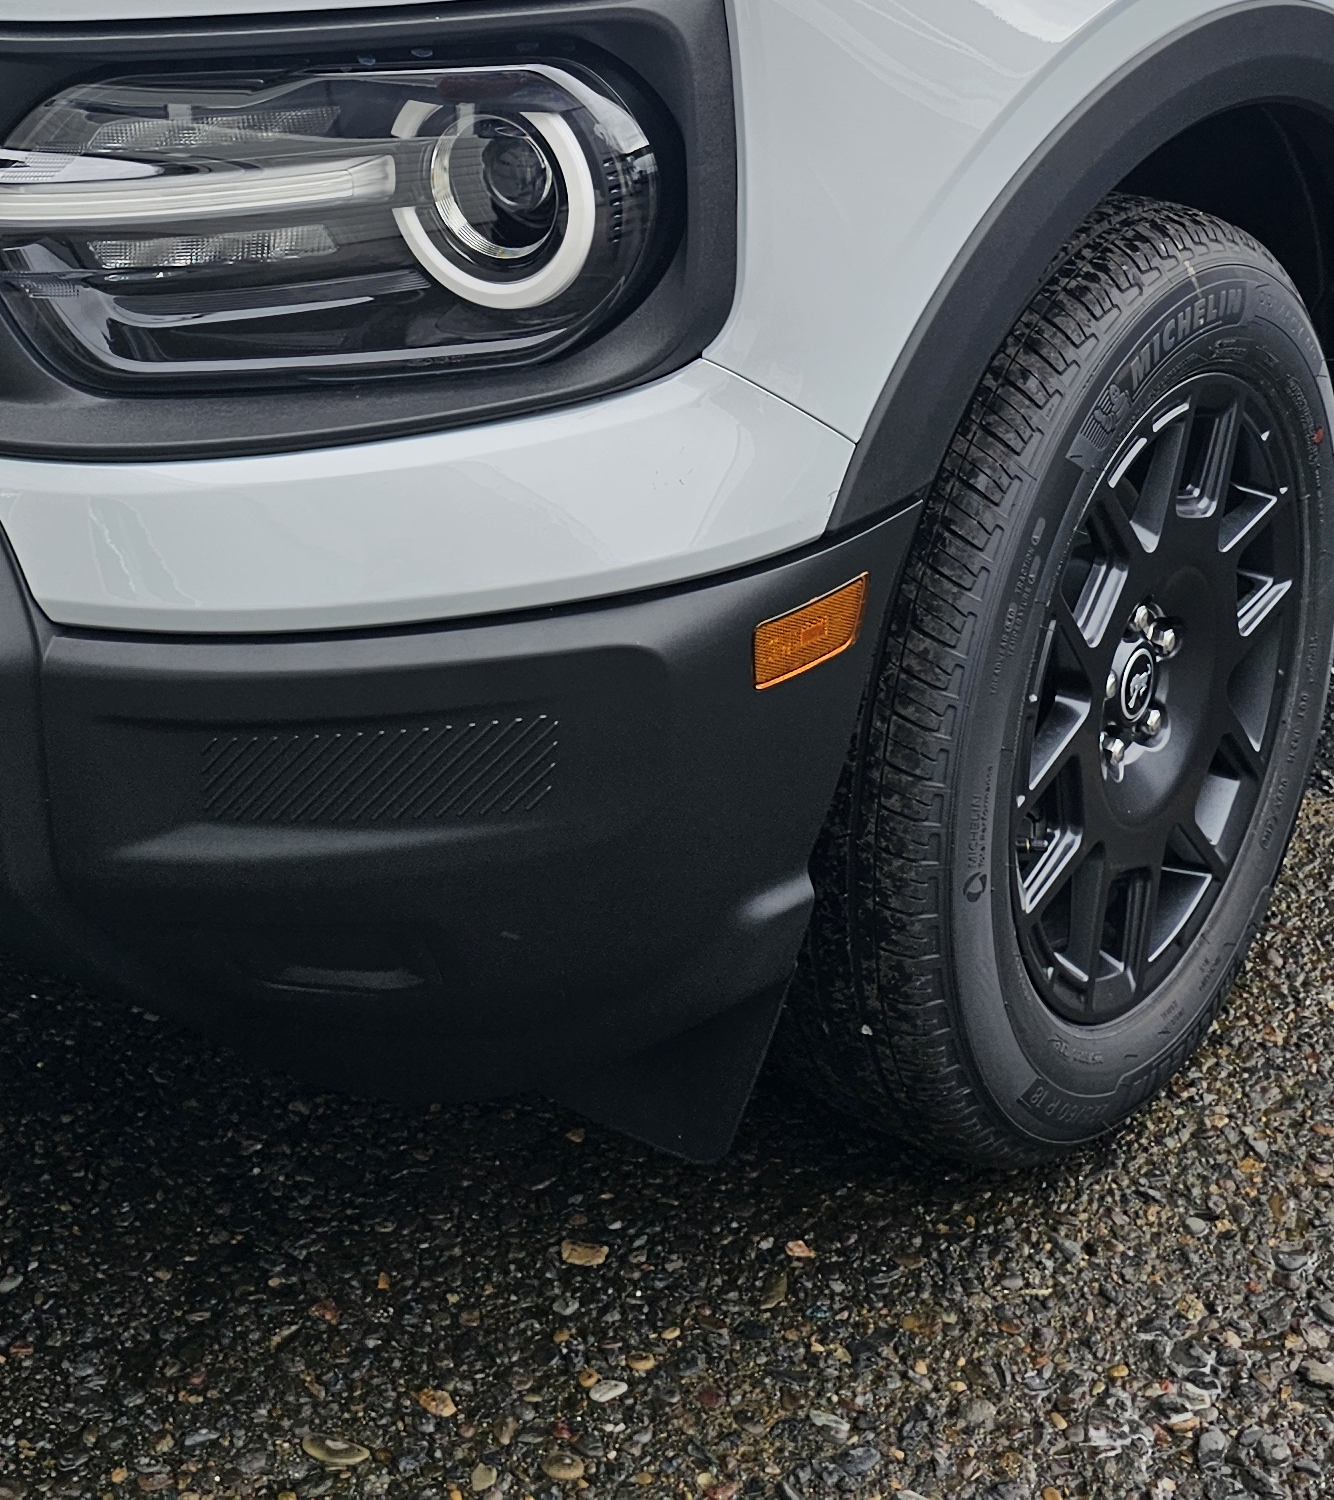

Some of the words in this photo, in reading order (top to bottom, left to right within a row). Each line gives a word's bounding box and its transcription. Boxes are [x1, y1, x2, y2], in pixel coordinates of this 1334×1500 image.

[1130, 288, 1242, 392] MICHELIN
[1014, 546, 1035, 595] TRACTION
[967, 793, 982, 869] MICHELIN
